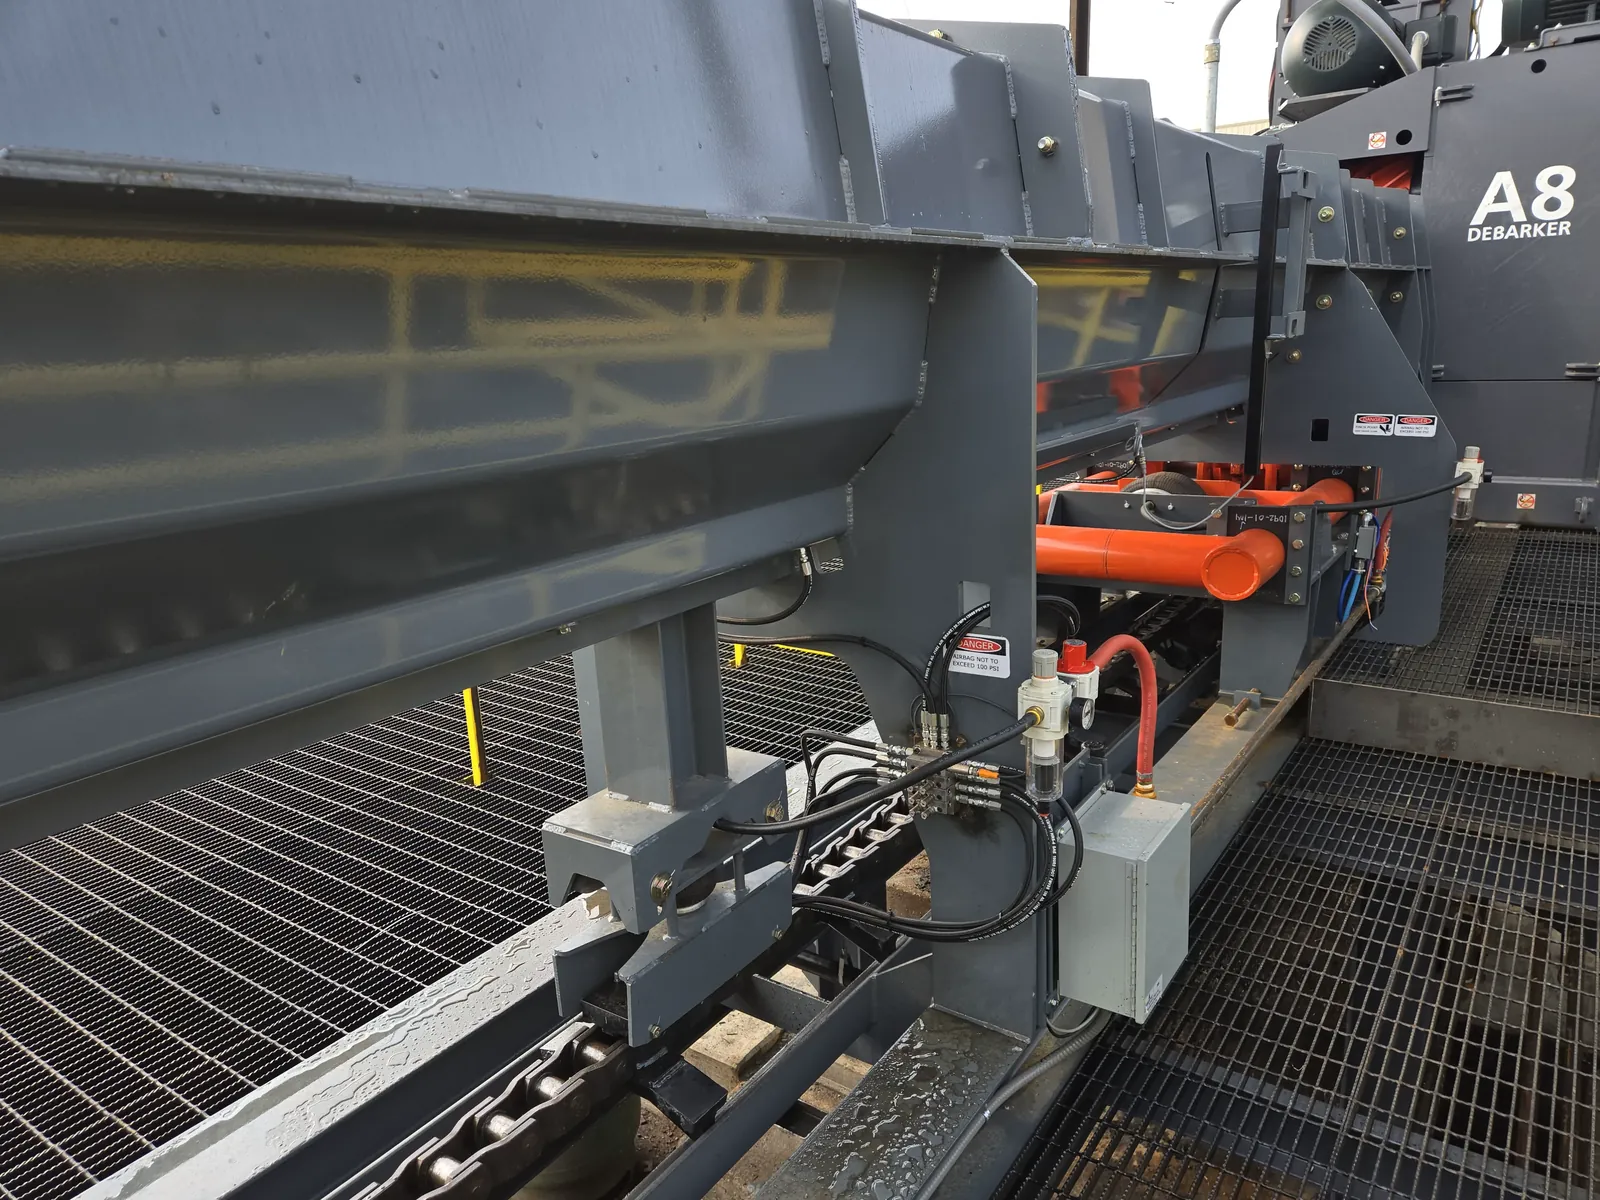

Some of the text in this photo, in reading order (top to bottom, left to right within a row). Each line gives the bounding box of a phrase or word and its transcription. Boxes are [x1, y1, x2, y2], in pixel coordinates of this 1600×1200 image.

[1469, 164, 1577, 226] A8
[1467, 221, 1572, 242] DEBARKER
[952, 660, 975, 669] EXCEED
[953, 653, 975, 662] AIRBAG
